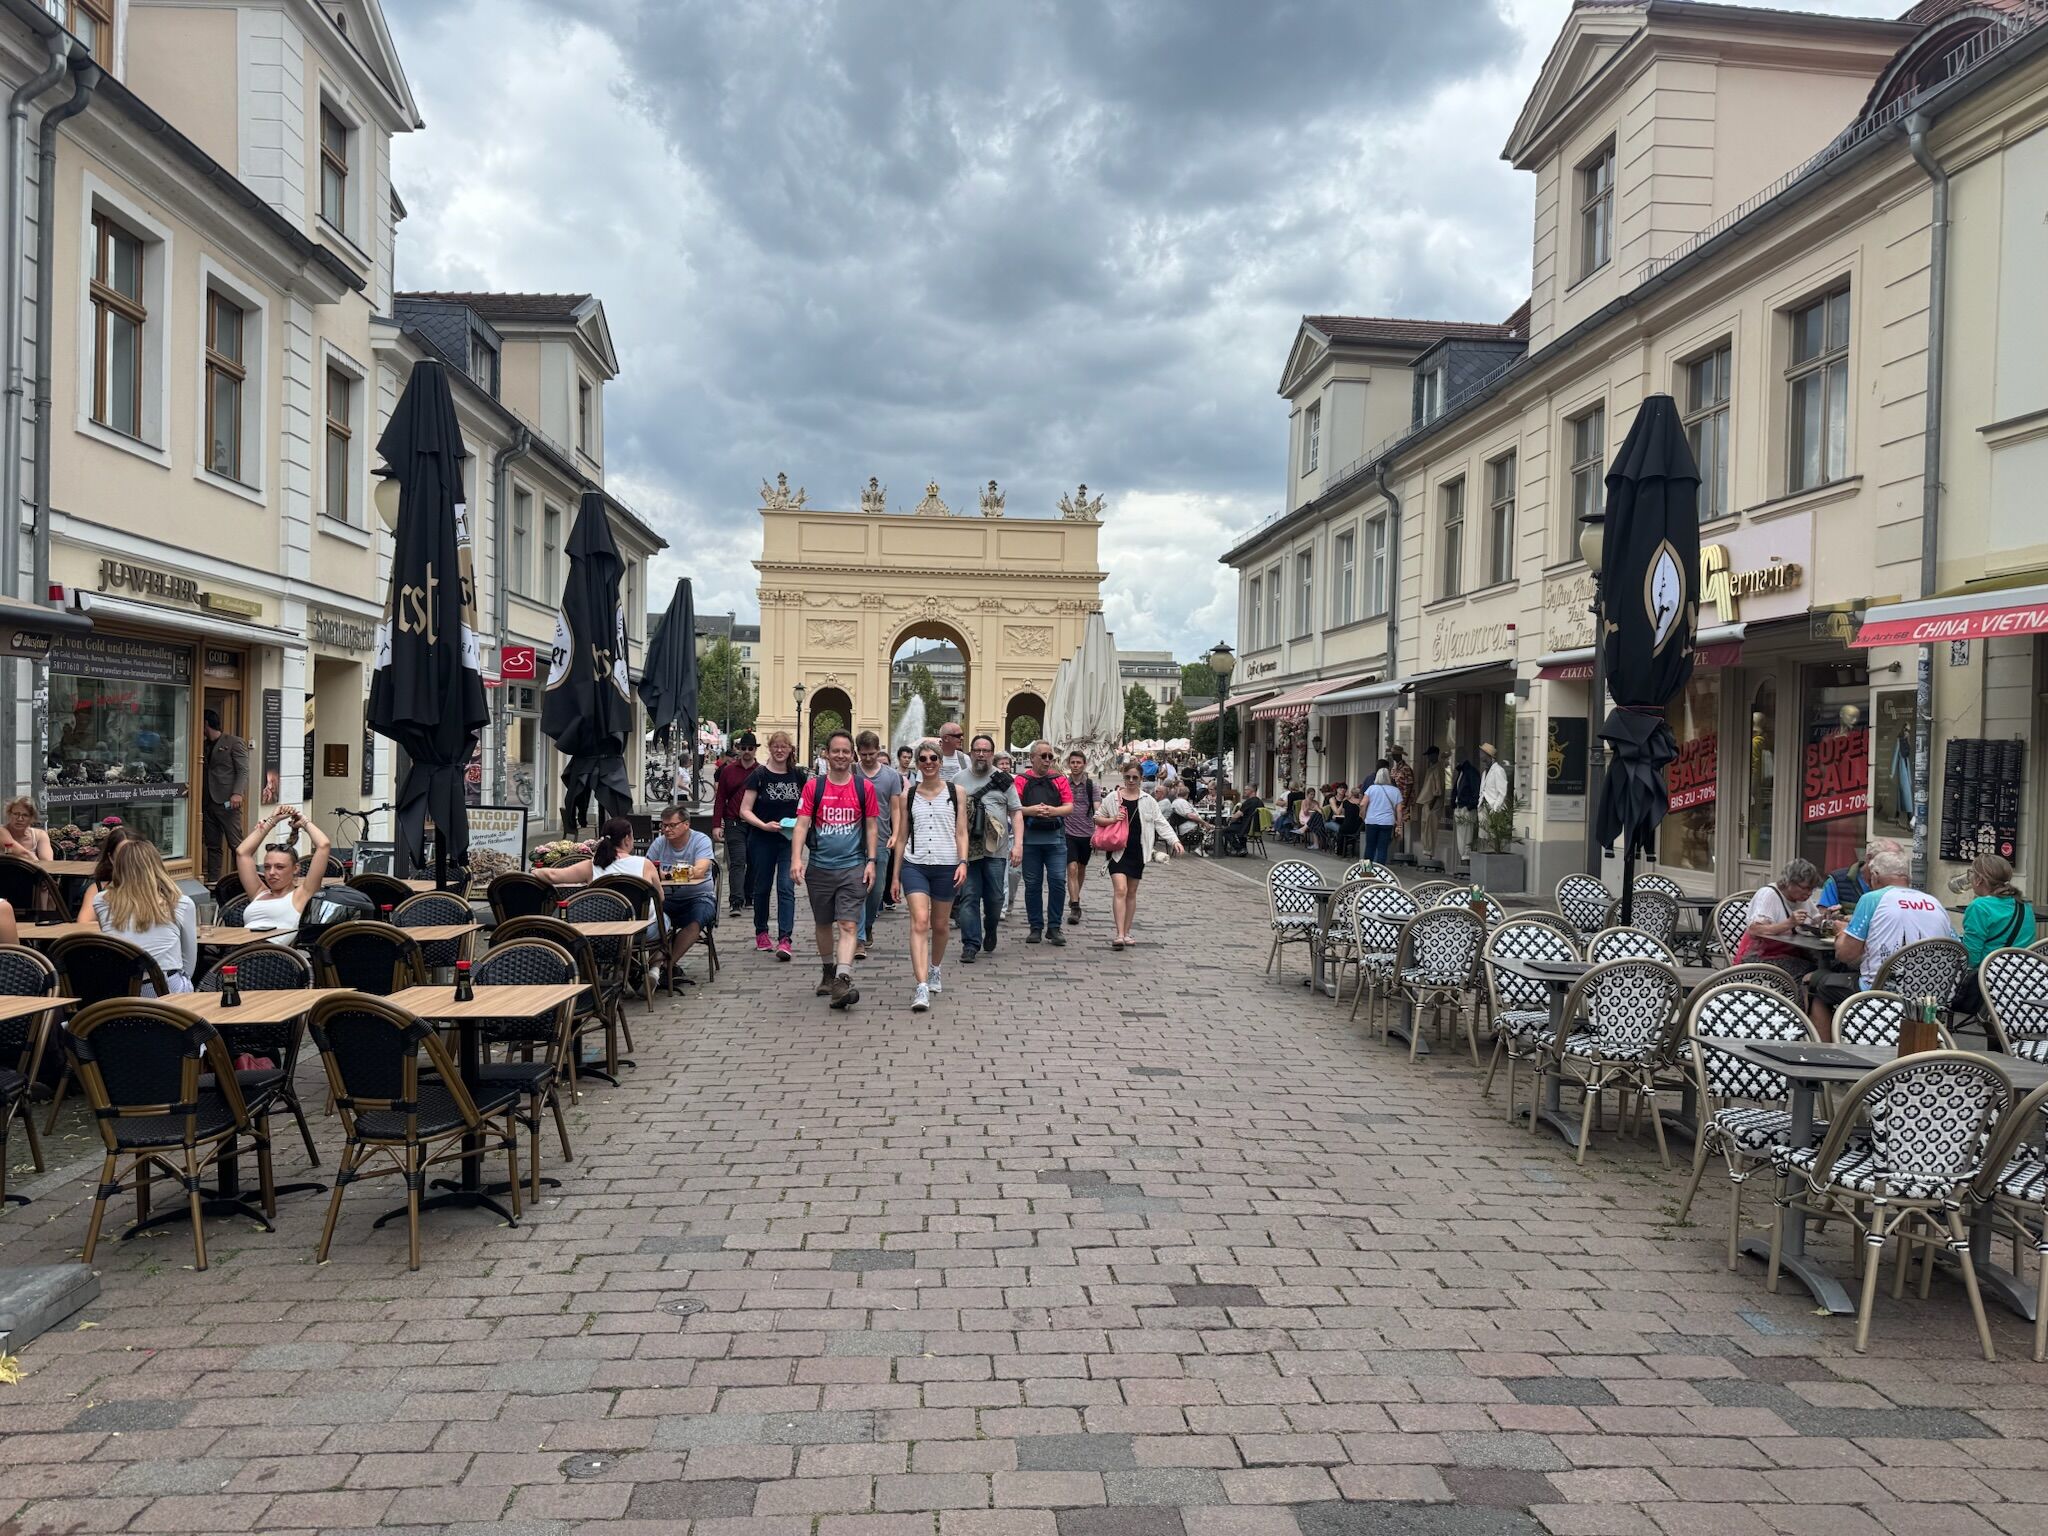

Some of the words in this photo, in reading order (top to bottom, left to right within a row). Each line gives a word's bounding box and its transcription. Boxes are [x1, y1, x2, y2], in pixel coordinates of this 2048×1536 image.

[97, 558, 200, 604] JUWELIER
[1913, 618, 1969, 638] CHINA
[66, 638, 82, 649] von
[86, 637, 105, 651] Gold
[107, 641, 123, 654] und
[125, 642, 173, 660] Edelmetallen
[209, 650, 229, 665] GOLD
[1668, 753, 1716, 792] SALE
[73, 789, 99, 801] Schmuck
[105, 788, 131, 800] Trauringe
[1670, 795, 1683, 808] BIS
[1684, 791, 1695, 804] ZU
[1697, 785, 1715, 801] -70%
[823, 805, 855, 821] team
[1808, 803, 1825, 818] BIS
[1828, 799, 1842, 814] ZU
[820, 822, 855, 836] power
[1898, 899, 1935, 911] swb
